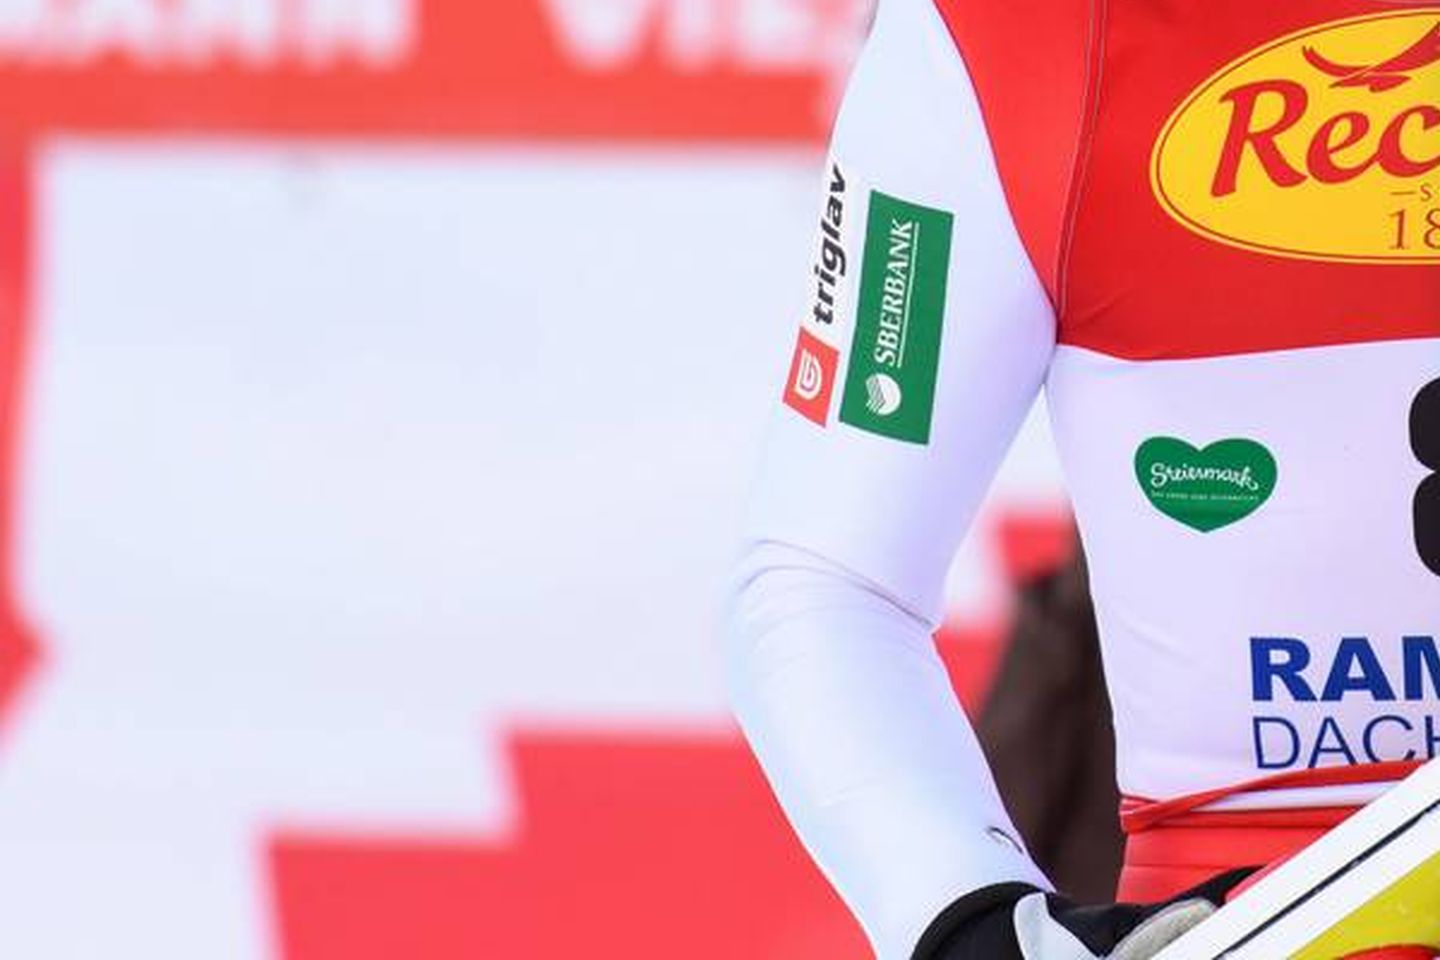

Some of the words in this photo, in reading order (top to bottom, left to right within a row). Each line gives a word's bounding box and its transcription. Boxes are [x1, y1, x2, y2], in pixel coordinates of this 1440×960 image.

[812, 162, 847, 326] triglav
[874, 218, 913, 368] SBERBANK
[1150, 462, 1259, 491] Steiermark
